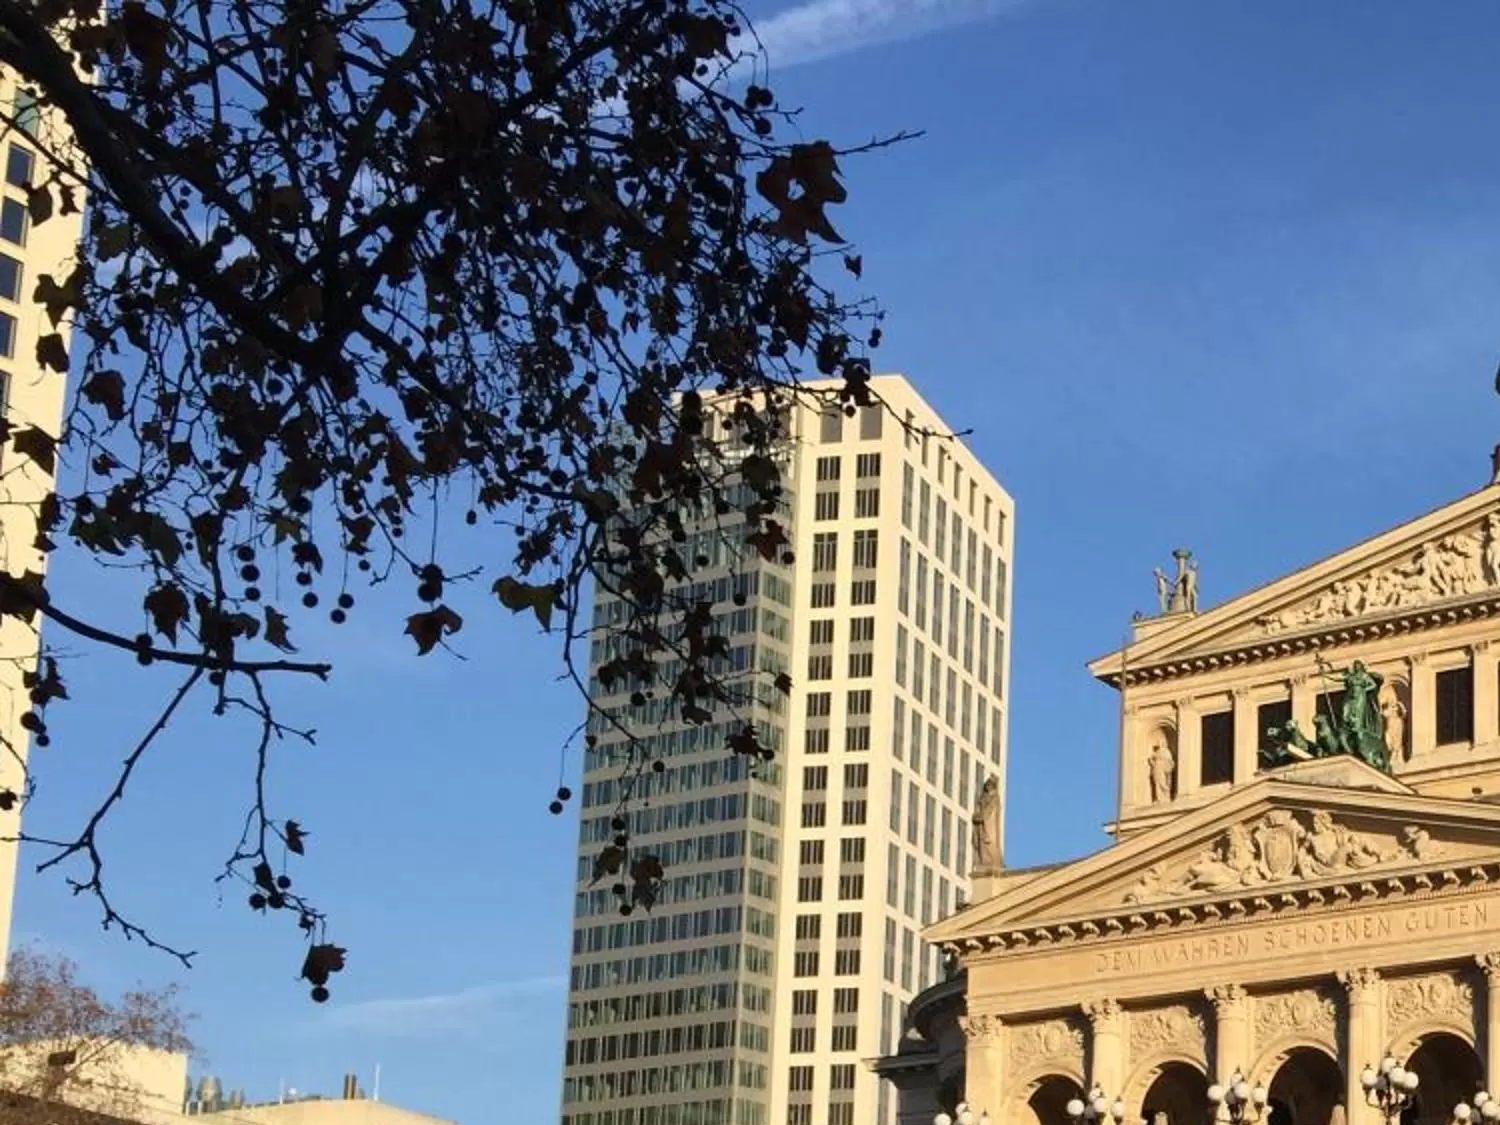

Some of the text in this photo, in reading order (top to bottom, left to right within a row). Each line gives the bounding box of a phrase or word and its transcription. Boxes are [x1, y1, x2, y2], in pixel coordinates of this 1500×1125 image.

[1096, 902, 1488, 974] DEM WAHREN SCHOENEN GUTEN
